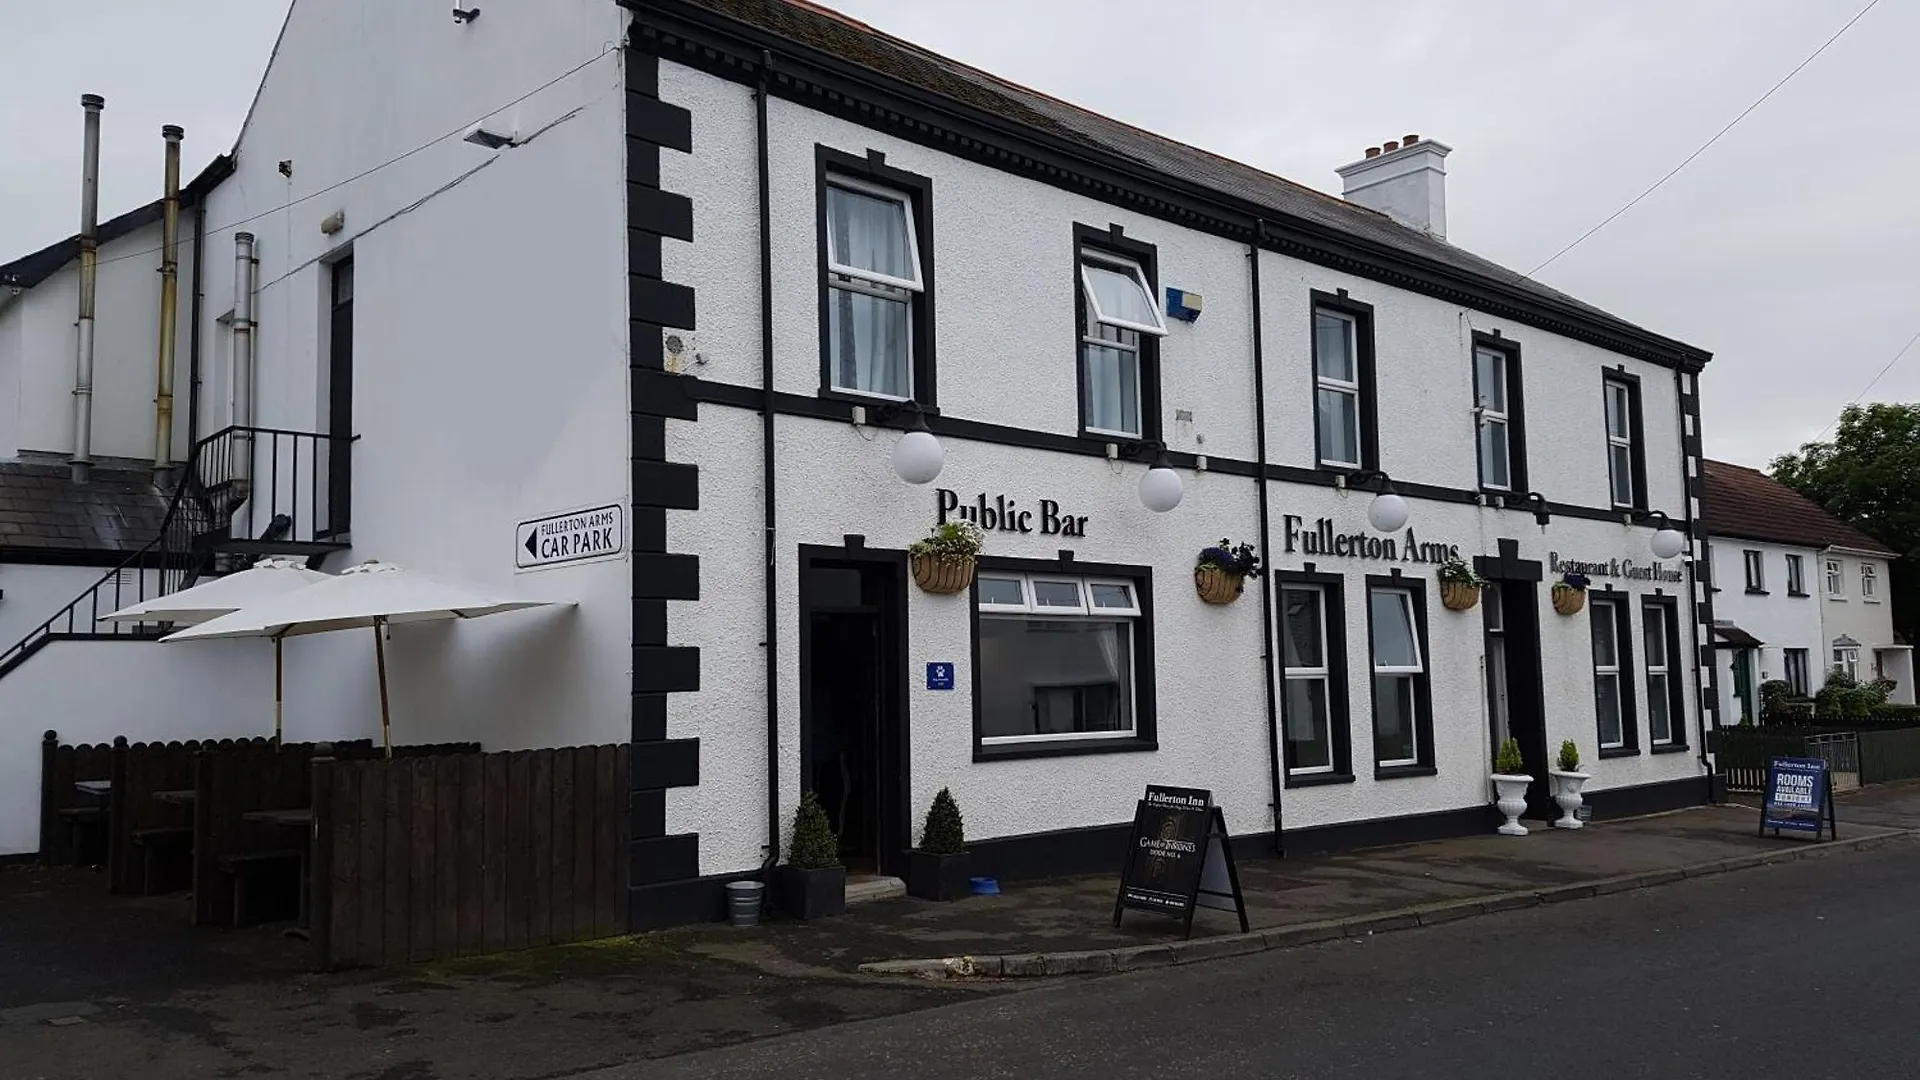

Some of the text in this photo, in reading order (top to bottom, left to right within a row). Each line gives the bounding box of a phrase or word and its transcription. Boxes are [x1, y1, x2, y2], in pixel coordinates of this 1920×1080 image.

[541, 512, 613, 535] FULLERTON ARMS
[935, 488, 1089, 537] Public Bar
[541, 527, 613, 558] CAR PARK
[1283, 514, 1459, 564] Fullerton Arms
[1549, 551, 1682, 583] Restaurant & Guest House
[1776, 786, 1813, 795] AVAILABLE
[1777, 774, 1813, 787] ROOMS
[1148, 792, 1204, 806] Fullerton Inn
[1139, 836, 1160, 849] GAME
